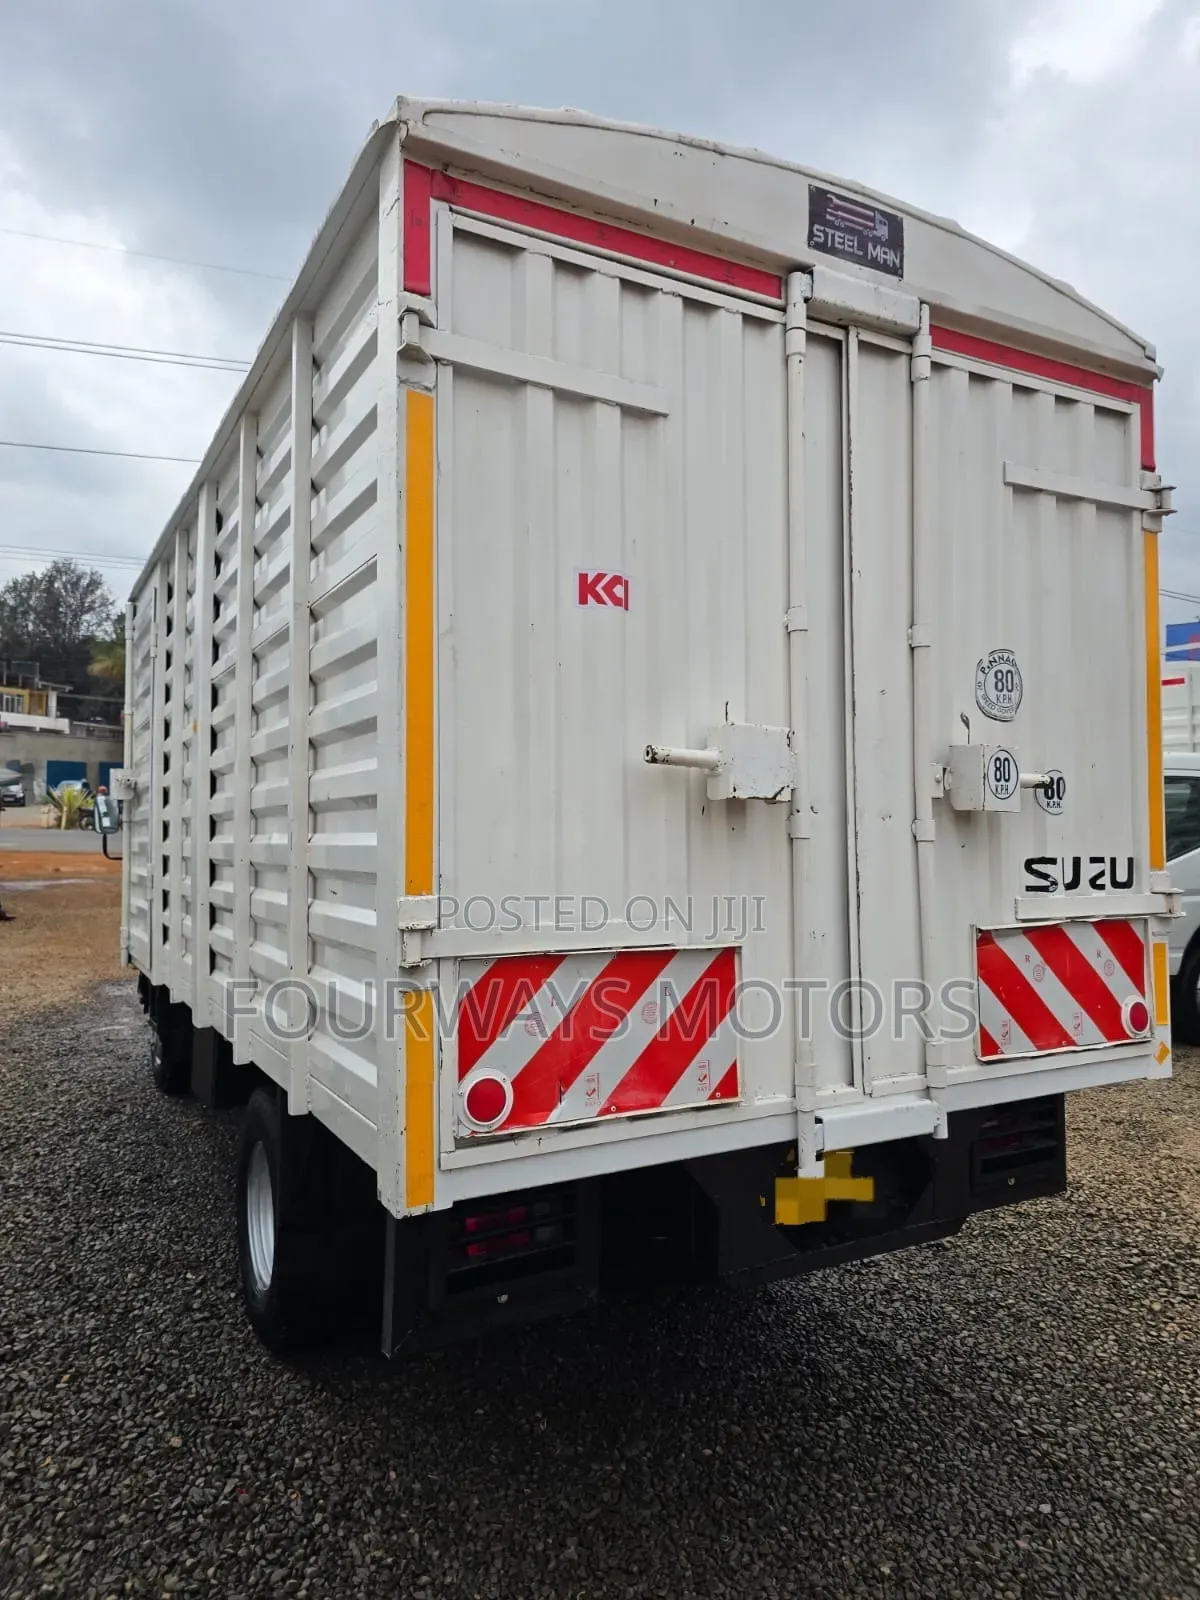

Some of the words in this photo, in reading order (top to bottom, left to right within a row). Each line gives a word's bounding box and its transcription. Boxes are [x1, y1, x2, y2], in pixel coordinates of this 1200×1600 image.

[812, 223, 863, 256] STEEL
[867, 241, 900, 268] MAN
[994, 669, 1014, 693] 80
[994, 757, 1011, 783] 80
[1043, 776, 1066, 801] 80
